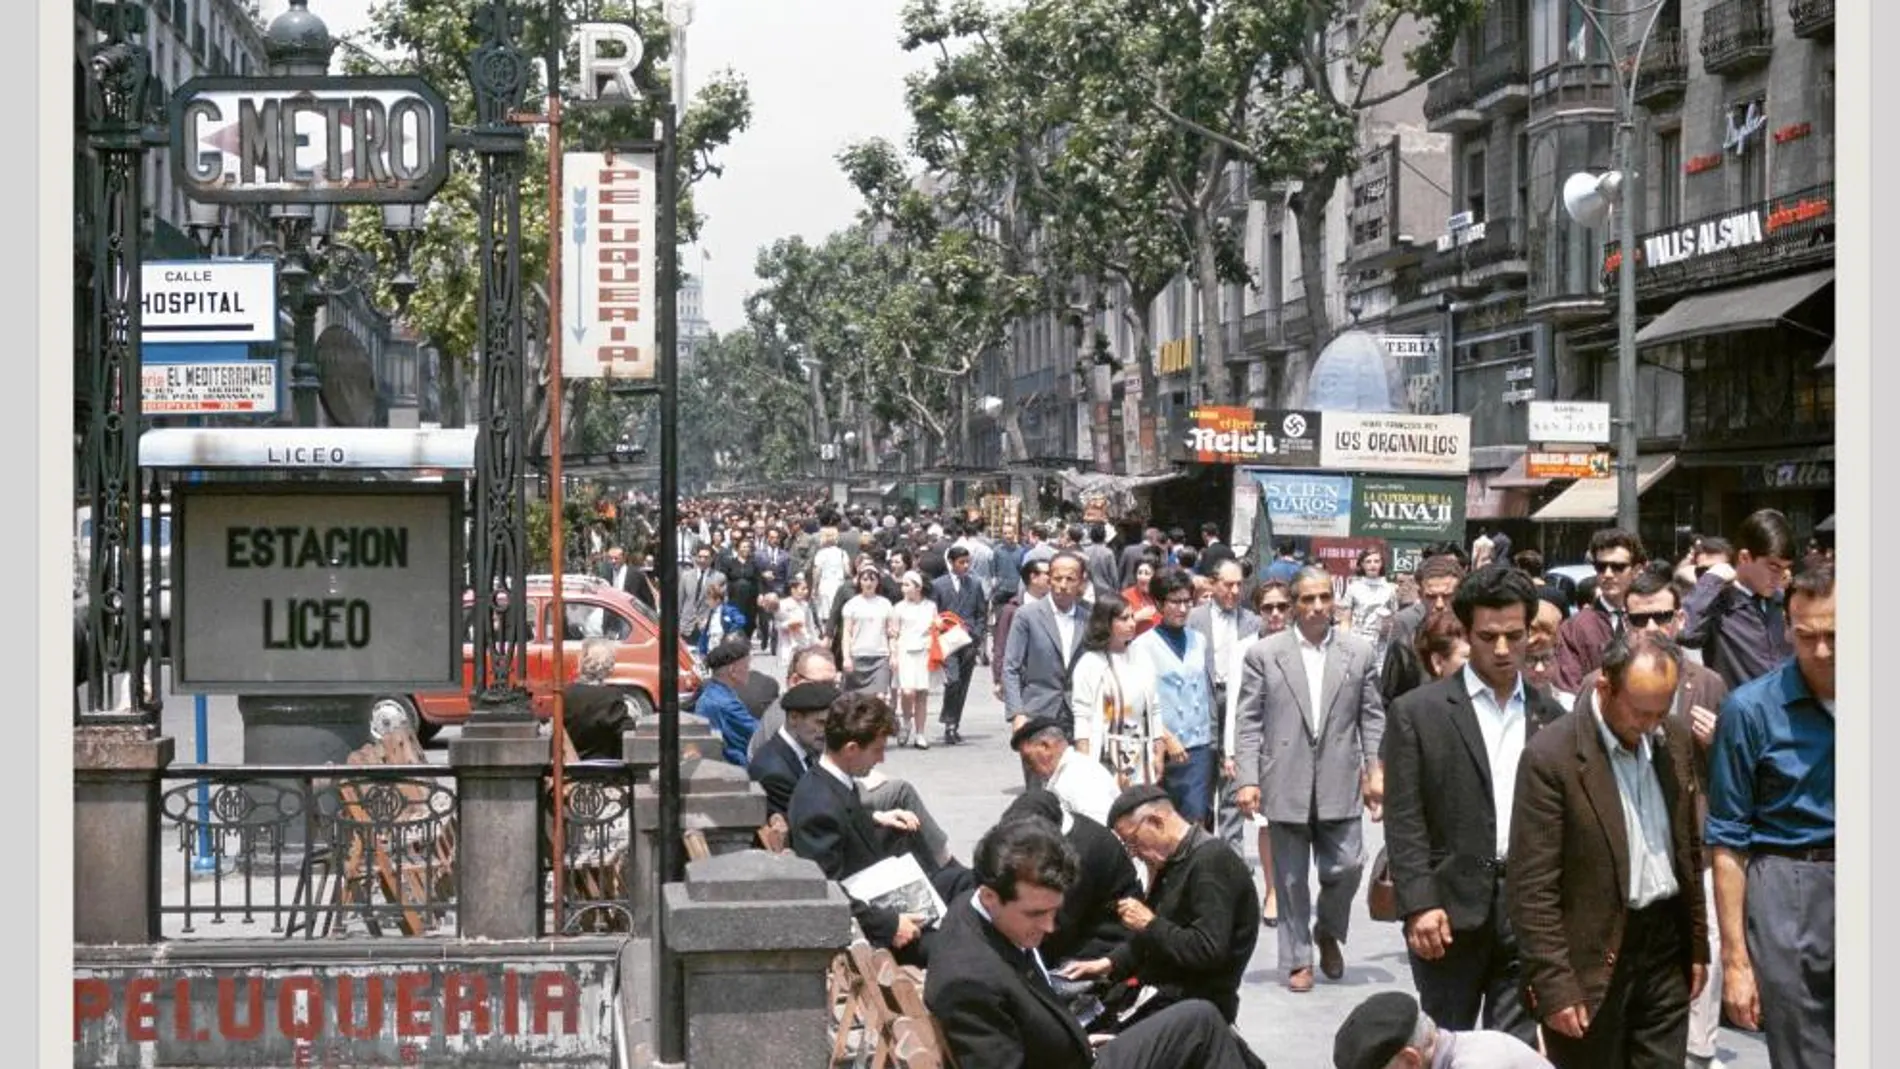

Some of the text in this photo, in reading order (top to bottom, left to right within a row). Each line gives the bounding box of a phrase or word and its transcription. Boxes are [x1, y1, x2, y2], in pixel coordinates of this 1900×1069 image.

[1645, 229, 1694, 268] VALLS
[165, 270, 212, 282] CALLE
[167, 366, 182, 387] EL
[185, 365, 272, 387] MEDITERRANEO
[1183, 427, 1278, 454] Reich
[1336, 430, 1361, 450] LOS
[1368, 432, 1458, 456] ORGANILLOS
[267, 447, 345, 463] LICEO
[1286, 483, 1338, 499] CIEN
[227, 527, 408, 568] ESTACION
[263, 599, 370, 650] LICEO
[73, 970, 580, 1042] PELUQUERIA
